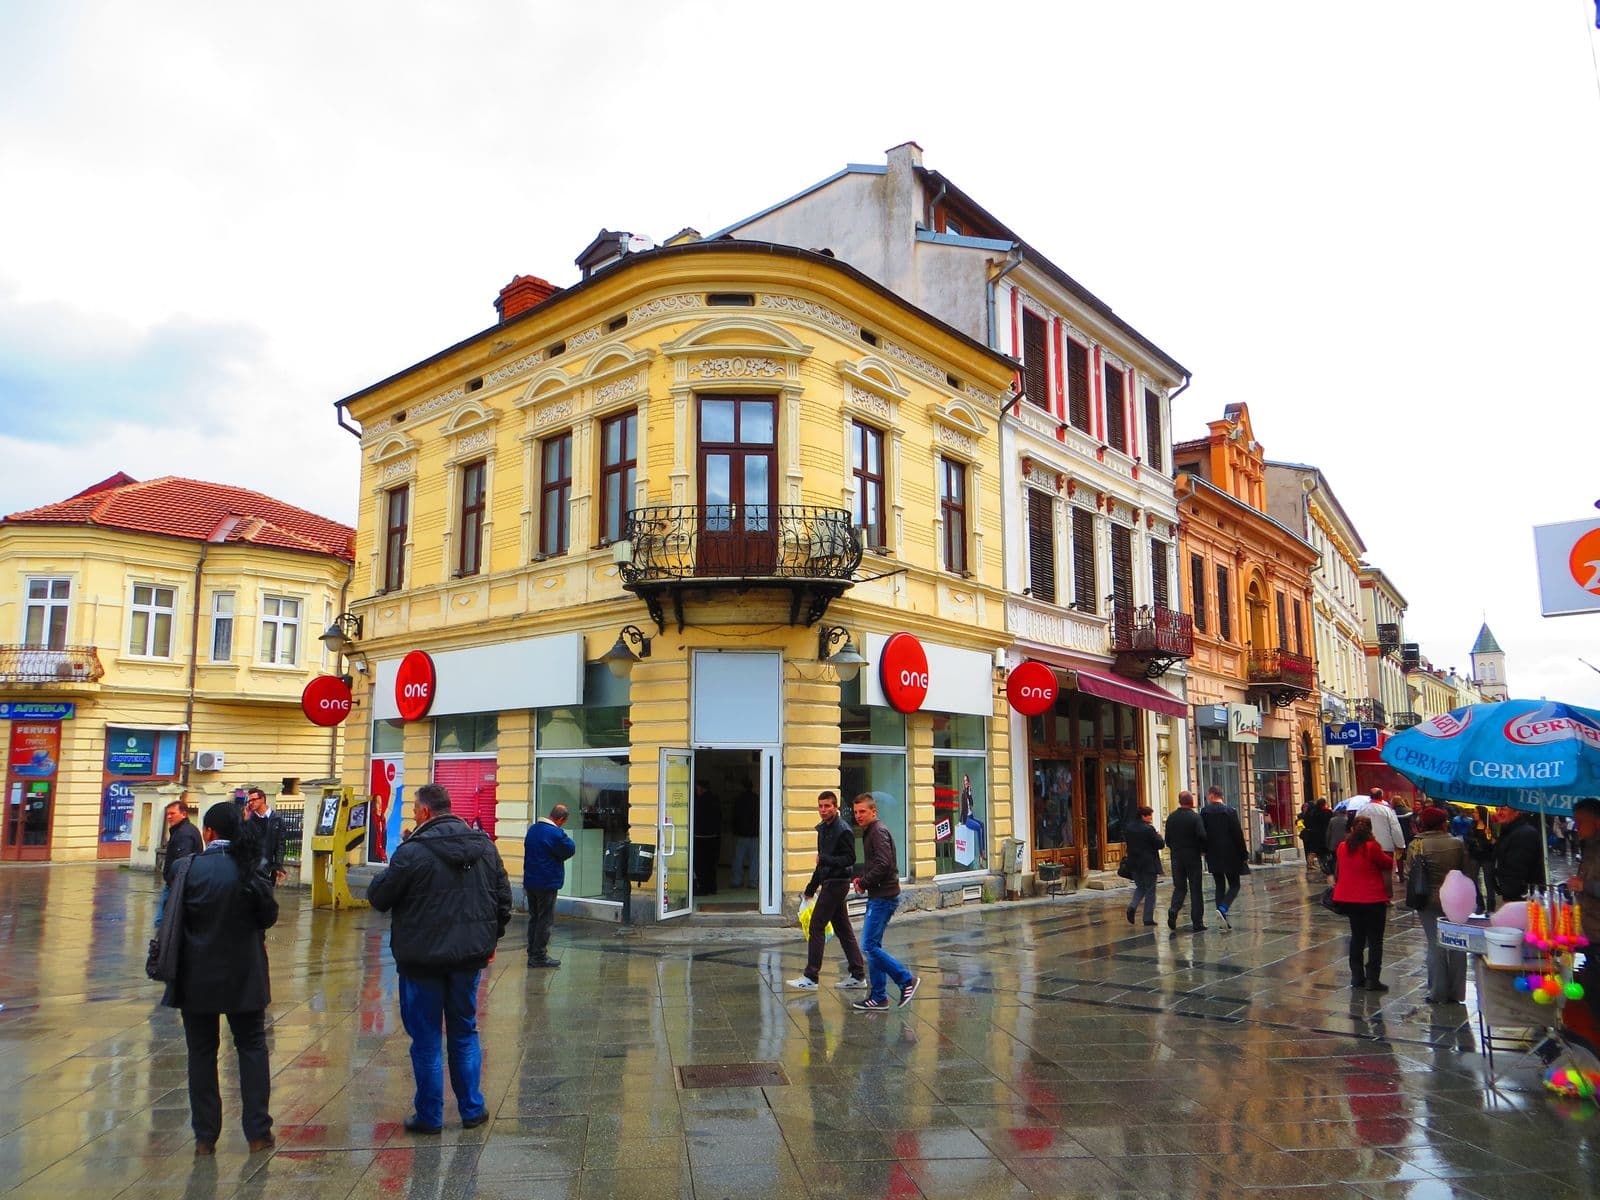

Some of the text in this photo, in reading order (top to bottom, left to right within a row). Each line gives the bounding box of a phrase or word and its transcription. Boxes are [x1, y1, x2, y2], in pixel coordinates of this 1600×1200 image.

[901, 670, 928, 688] one
[404, 683, 428, 697] one
[1021, 687, 1052, 699] one
[320, 699, 348, 709] one
[16, 726, 57, 734] FERVEX
[1330, 731, 1348, 740] NLB
